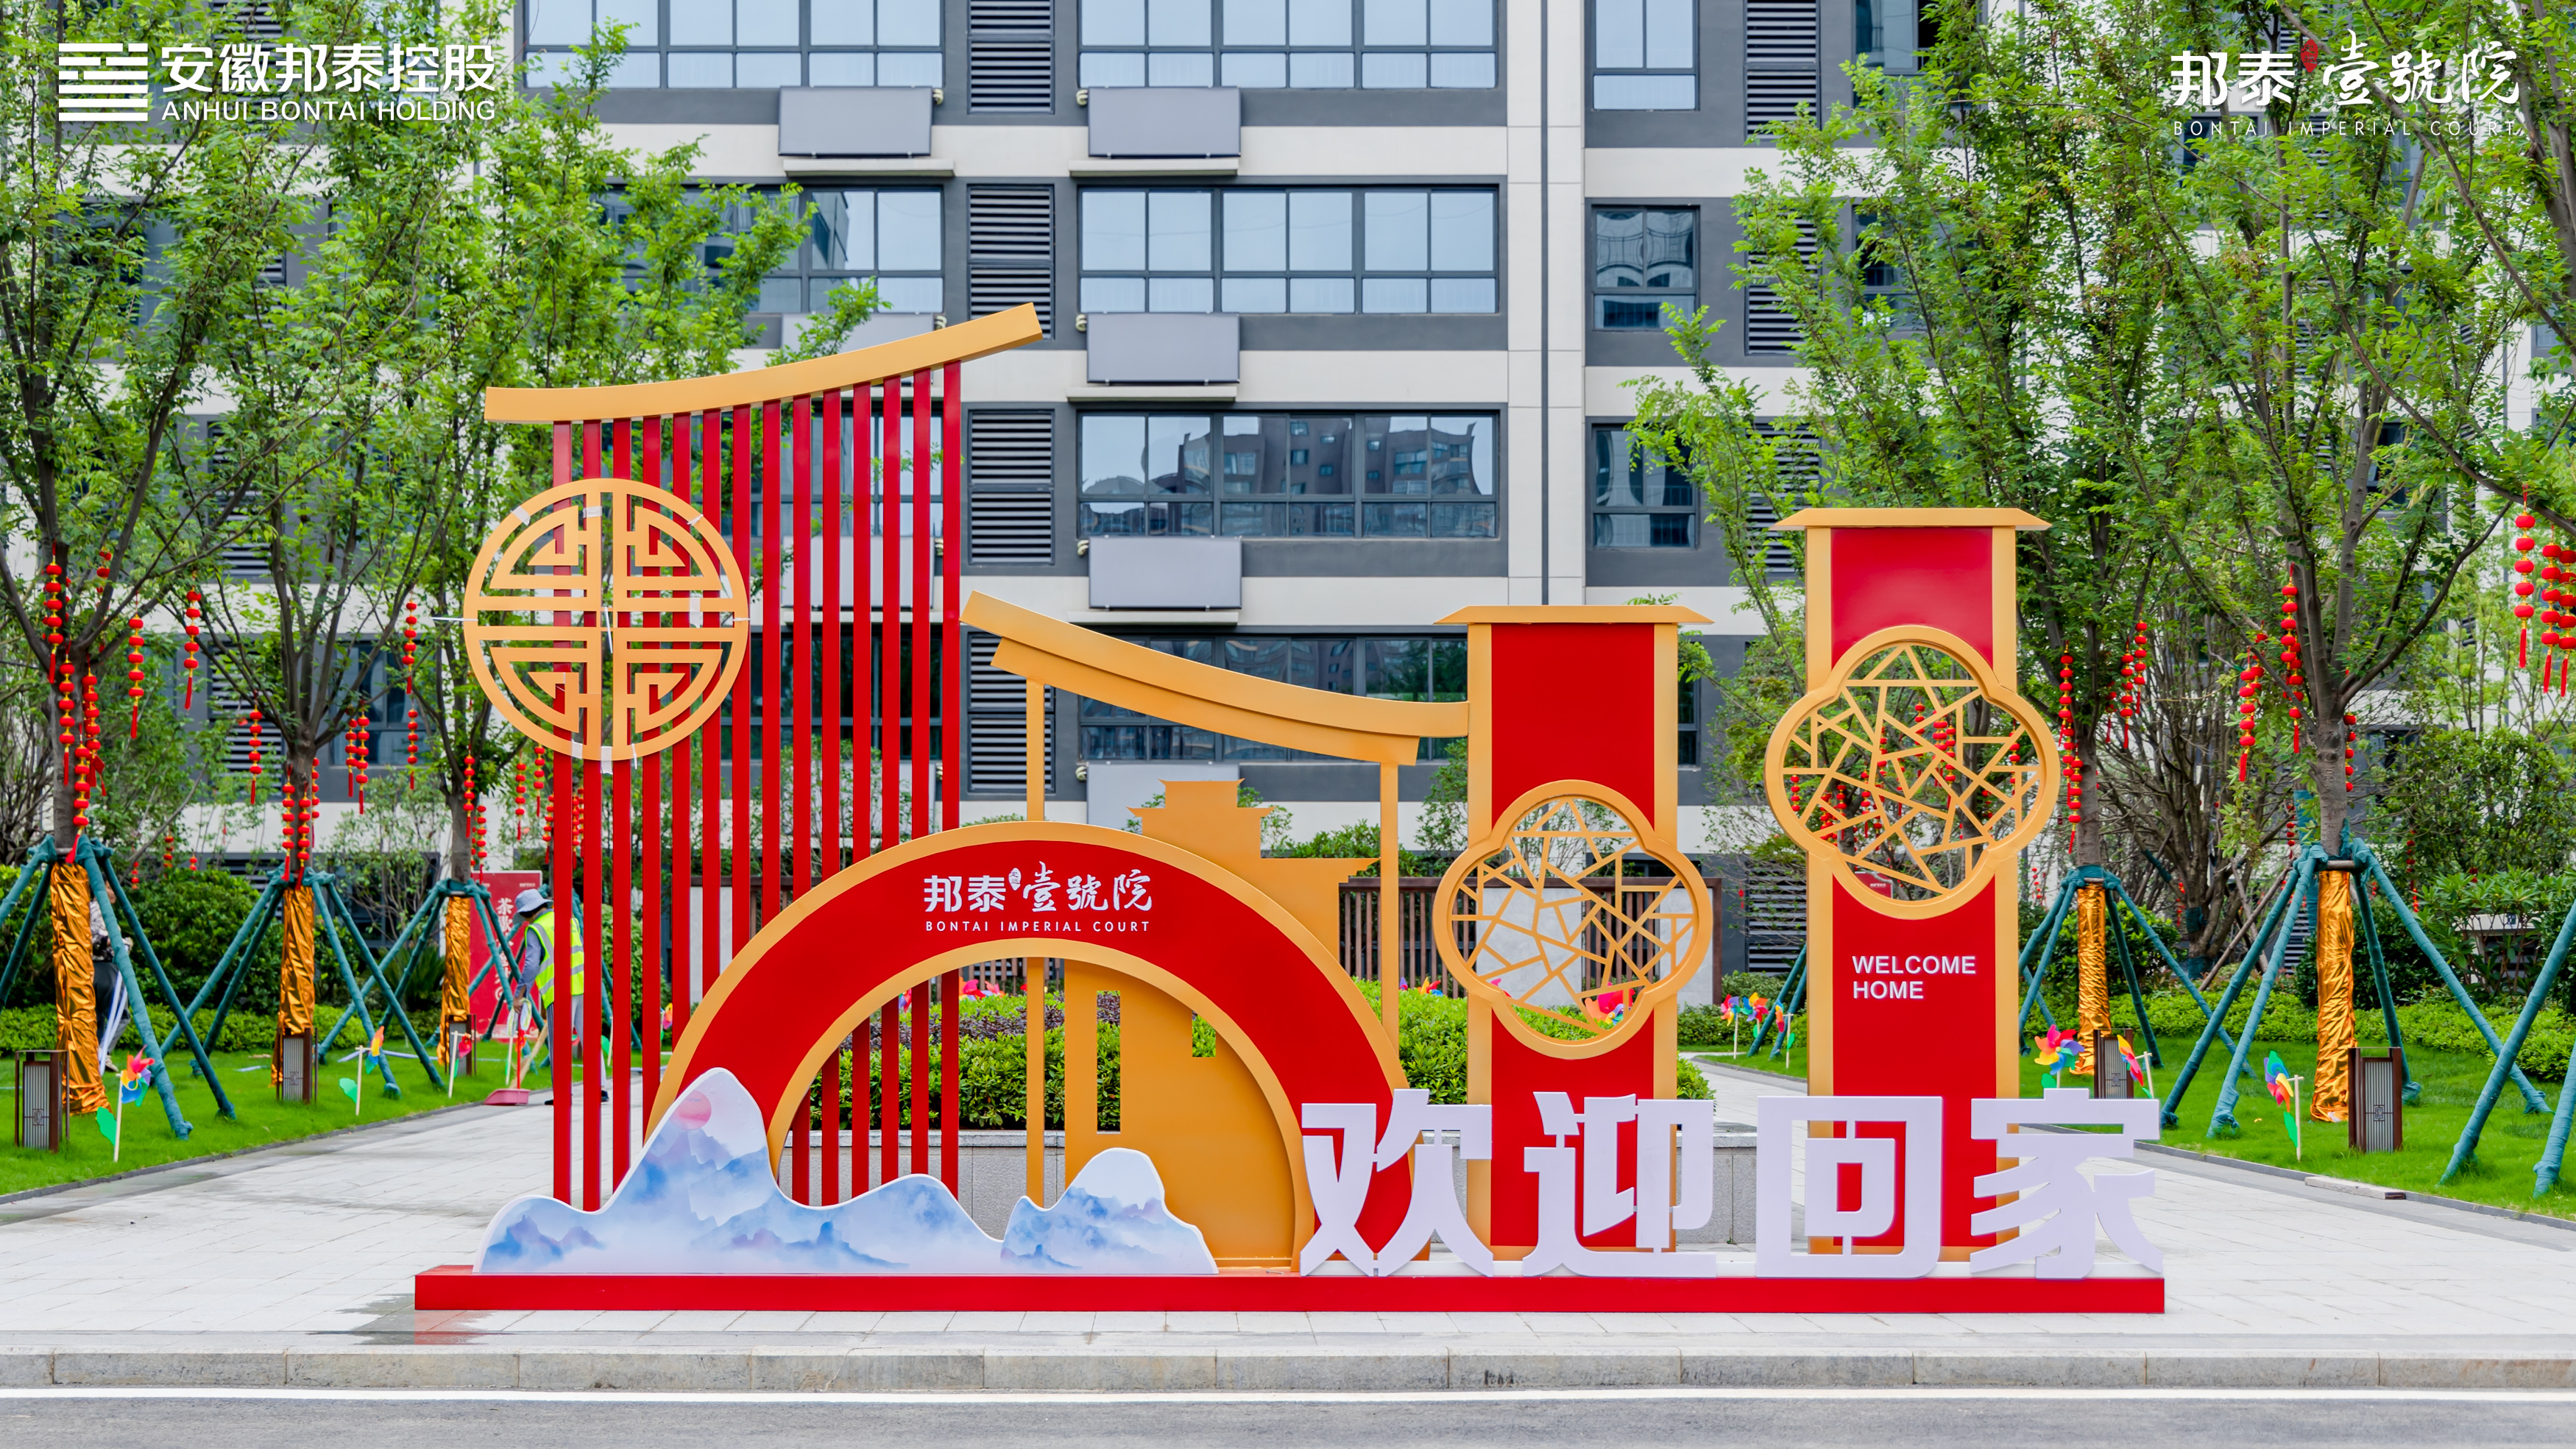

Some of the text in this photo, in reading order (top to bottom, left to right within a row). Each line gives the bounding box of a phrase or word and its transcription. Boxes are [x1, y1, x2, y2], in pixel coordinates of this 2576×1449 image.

[923, 860, 1153, 913] 邦泰 壹號院
[925, 921, 1150, 932] BONTAI IMPERIAL COURT
[1851, 955, 1977, 974] WELCOME
[1853, 980, 1924, 999] HOME
[1300, 1088, 2163, 1279] 欢迎回家
